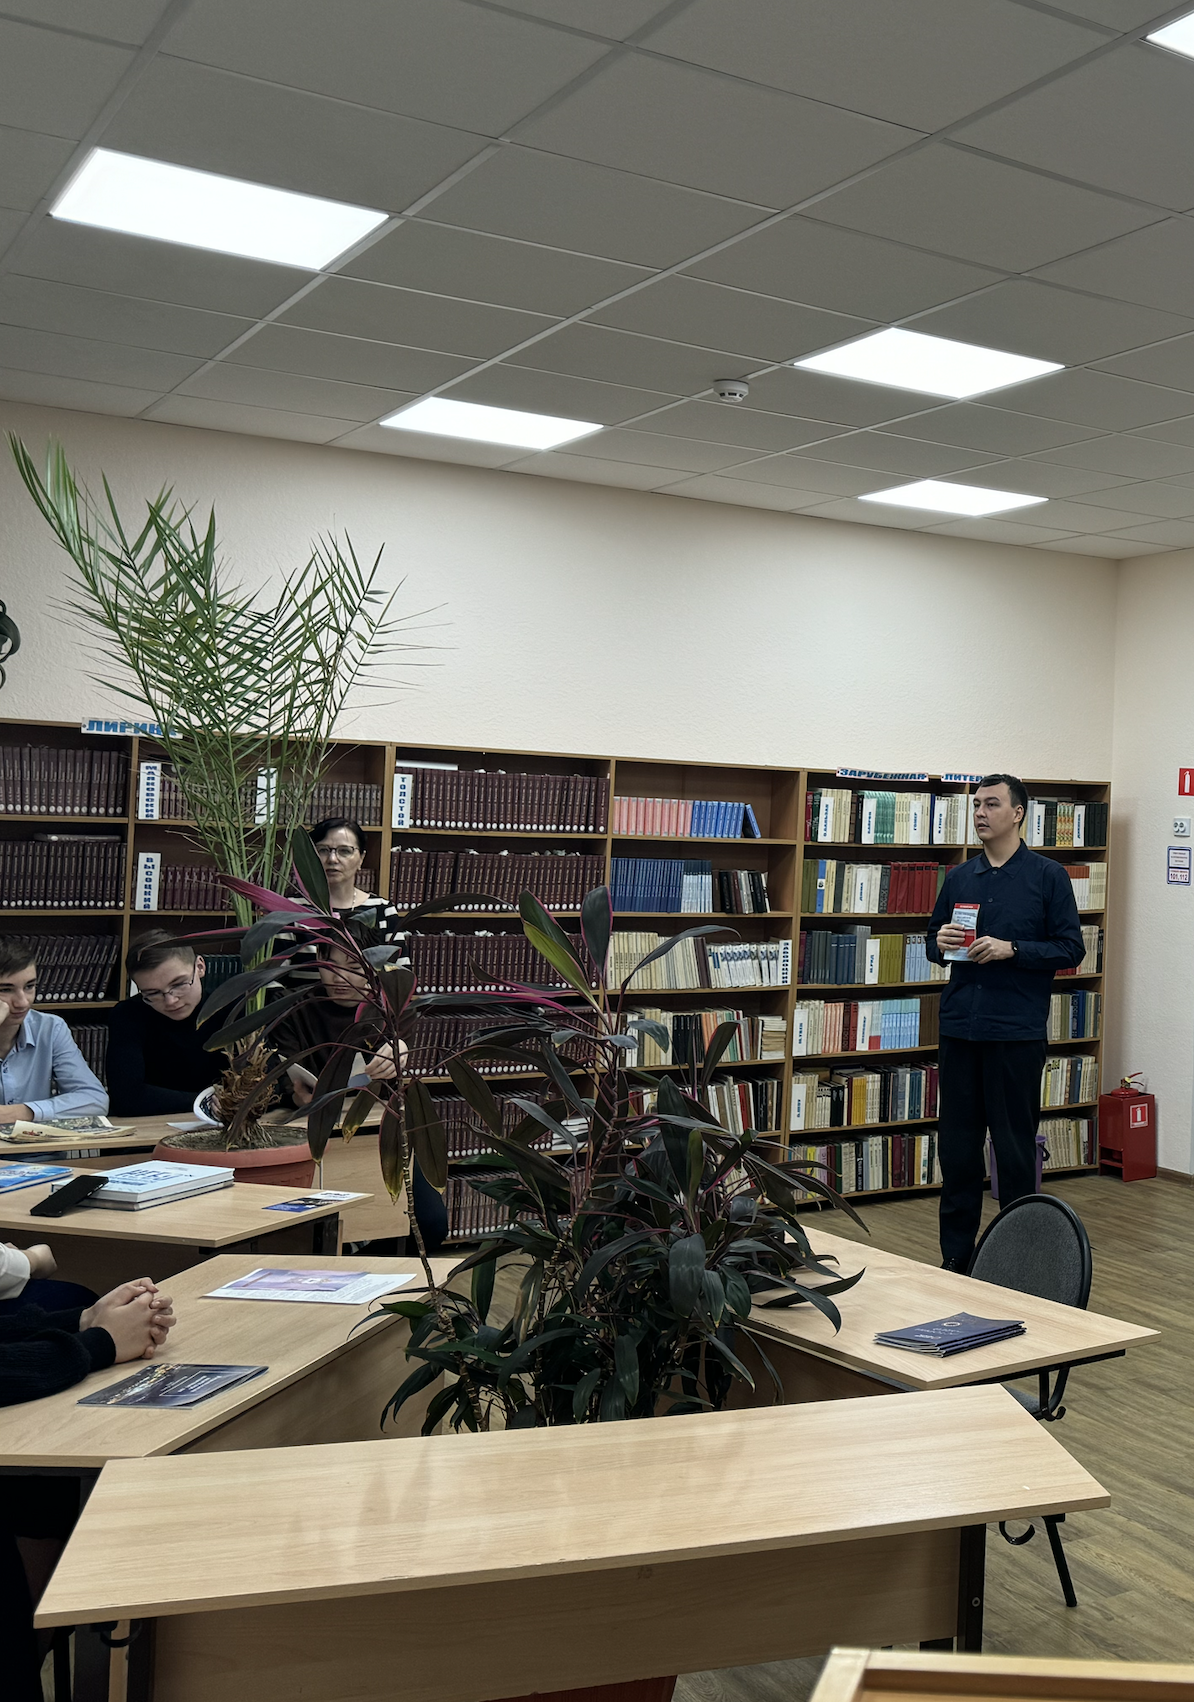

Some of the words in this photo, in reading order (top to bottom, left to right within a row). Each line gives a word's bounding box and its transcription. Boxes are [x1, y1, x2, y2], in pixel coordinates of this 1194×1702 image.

[145, 765, 157, 818] МАЯКОВСКИЙ
[840, 768, 928, 780] ЗАРУБЕЖНАЯ
[944, 773, 983, 782] ЛИТЕР
[397, 777, 407, 826] ТОЛСТОЙ
[143, 857, 155, 909] ВЫСОЦКИЙ
